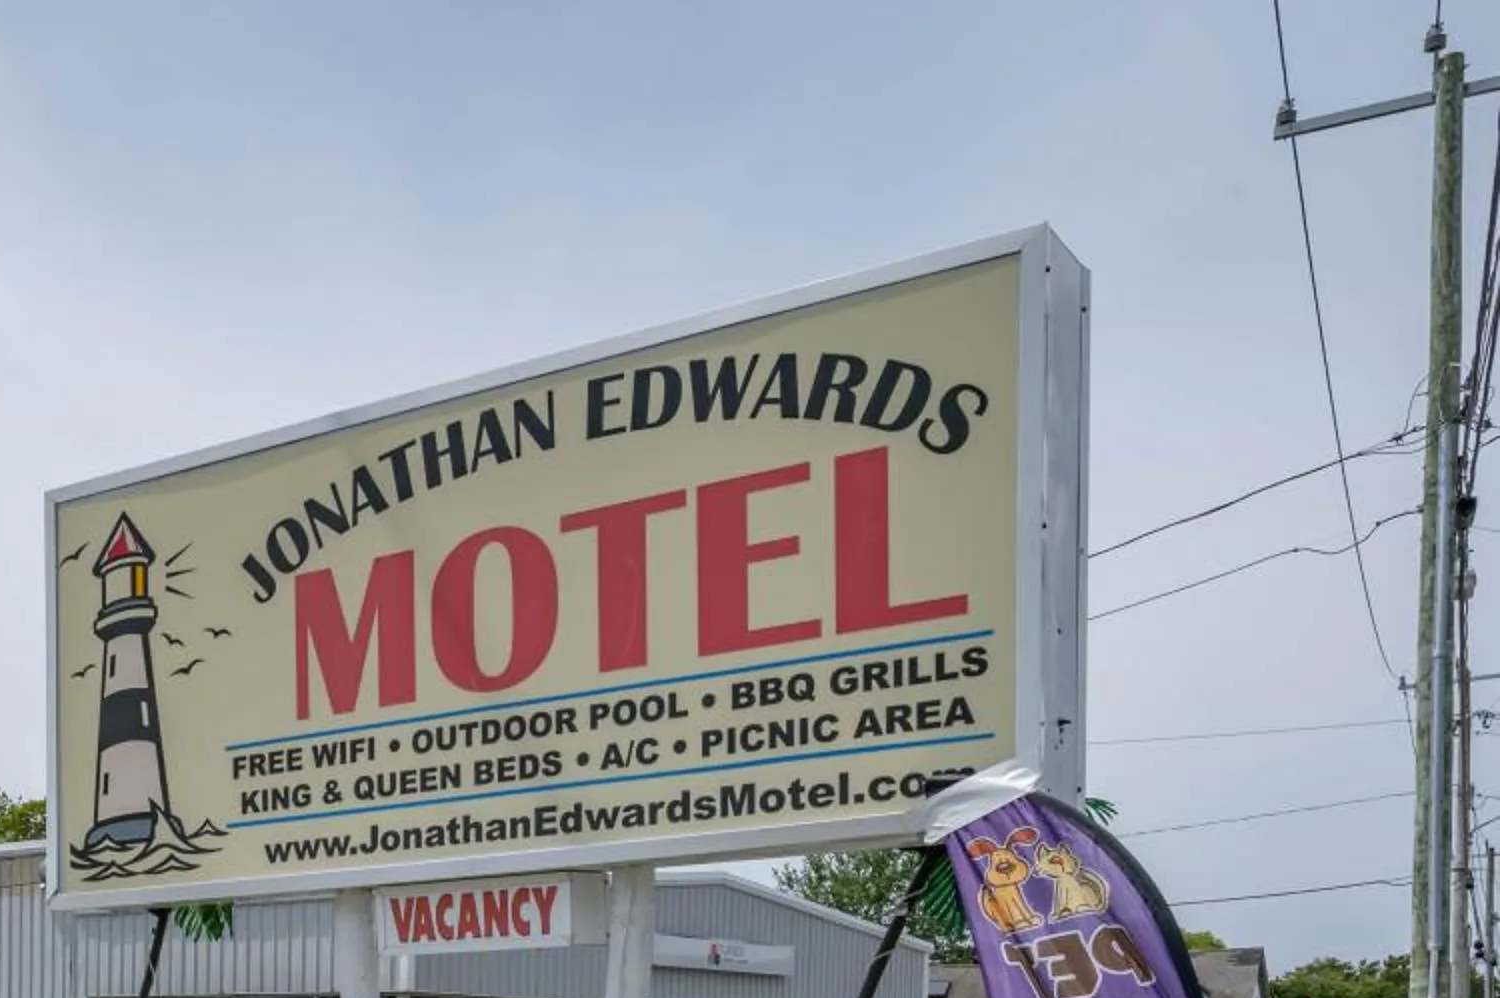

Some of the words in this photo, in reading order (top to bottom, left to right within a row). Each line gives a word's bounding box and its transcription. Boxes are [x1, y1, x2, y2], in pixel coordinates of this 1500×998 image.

[241, 388, 556, 605] JONATHAN
[586, 351, 989, 456] EDWARDS
[294, 445, 970, 722] MOTEL
[232, 746, 304, 781] FREE
[312, 735, 377, 769] WIFI
[411, 707, 578, 756] OUTDOOR
[588, 692, 689, 731] POOL
[731, 672, 816, 712] BBQ
[829, 646, 990, 697] GRILLS
[240, 781, 312, 816] KING
[322, 780, 343, 806] &
[353, 762, 462, 802] QUEEN
[473, 750, 563, 787] BEDS
[600, 737, 660, 772] A/C
[700, 713, 840, 758] PICNIC
[853, 695, 976, 740] AREA
[264, 765, 977, 864] www.JonathanEdwardsMotel.co
[389, 885, 559, 943] VACANCY
